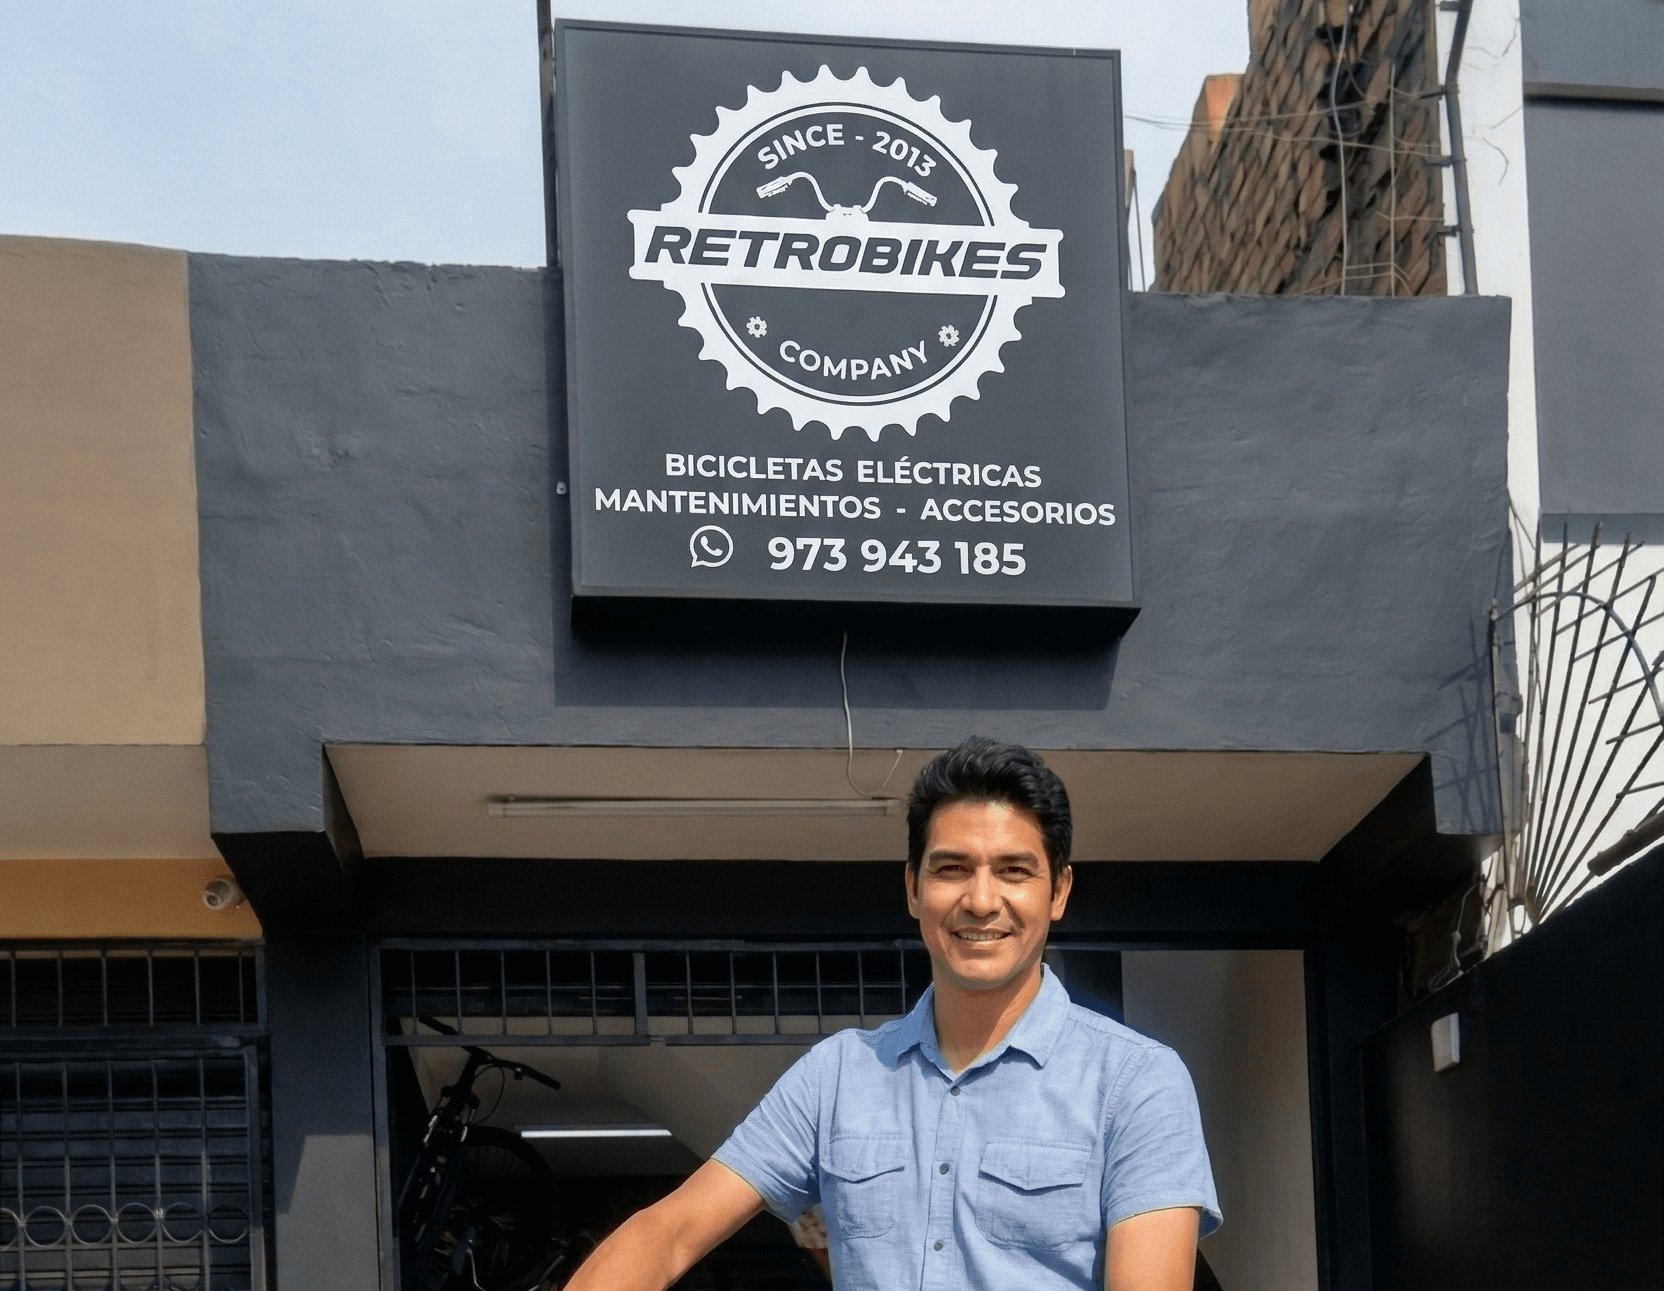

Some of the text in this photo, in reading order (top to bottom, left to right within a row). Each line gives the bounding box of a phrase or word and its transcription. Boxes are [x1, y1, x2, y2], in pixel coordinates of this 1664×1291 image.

[757, 123, 845, 170] SINCE
[872, 131, 938, 177] 2013
[644, 225, 1048, 281] RETROBIKES
[779, 339, 929, 381] COMPANY
[665, 453, 1042, 488] BICICLETAS ELÉCTRICAS
[595, 487, 882, 520] MANTENIMIENTOS
[920, 498, 1116, 526] ACCESORIOS
[767, 536, 1026, 576] 973 943 185
